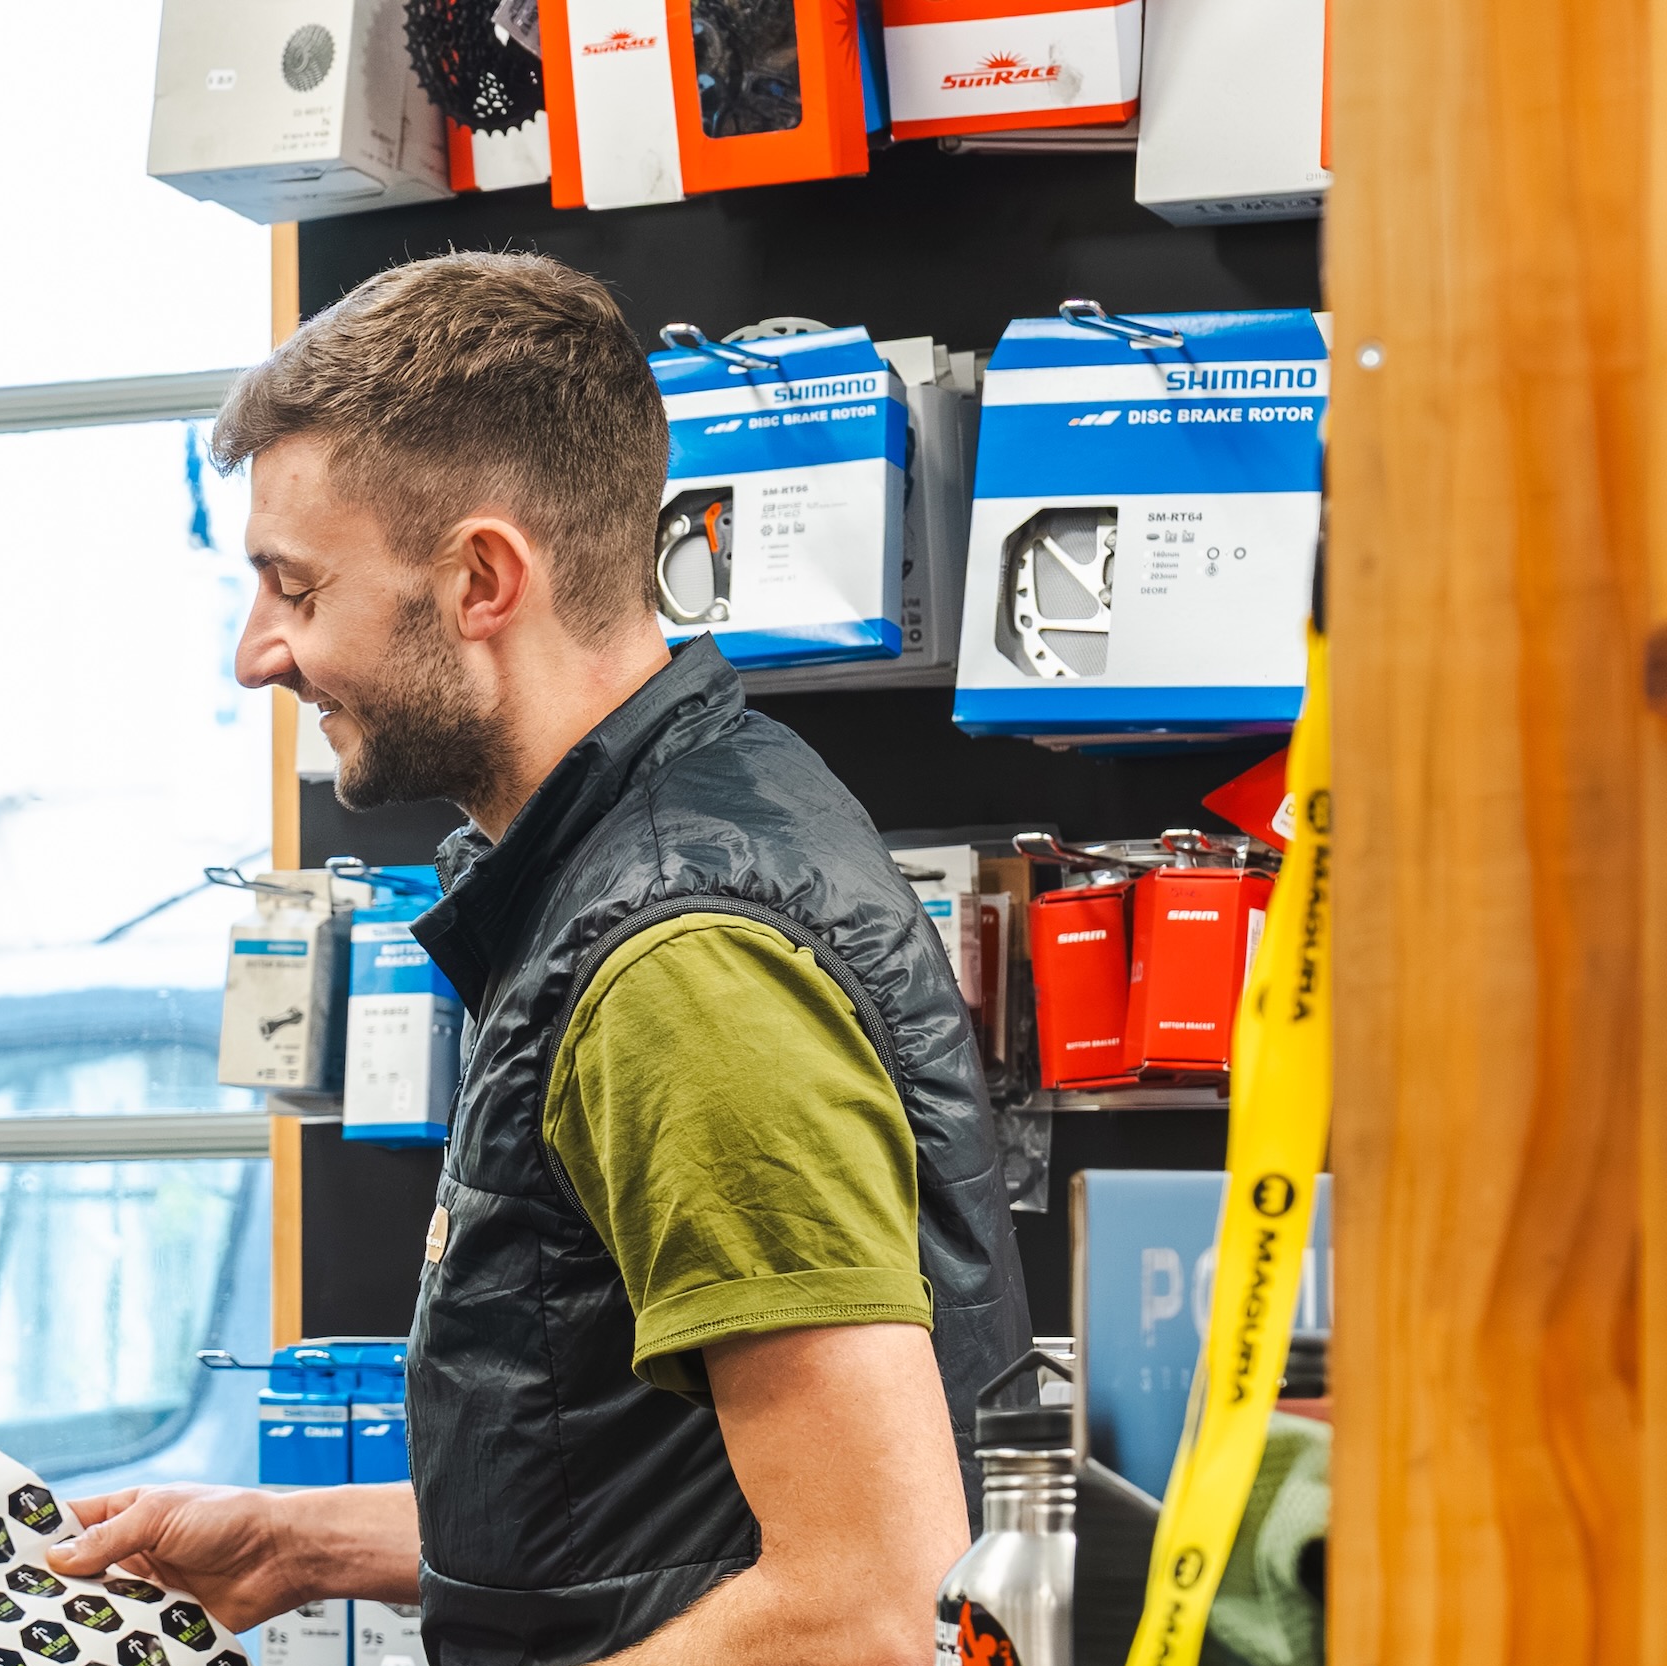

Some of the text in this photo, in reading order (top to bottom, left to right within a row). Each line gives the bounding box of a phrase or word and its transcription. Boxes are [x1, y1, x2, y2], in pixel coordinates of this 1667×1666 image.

[1166, 368, 1317, 391] SHIMANO
[773, 378, 876, 403] SHIMANO
[748, 405, 877, 430] DISC BRAKE ROTOR
[1127, 406, 1314, 425] DISC BRAKE ROTOR
[1147, 511, 1203, 522] SM-RT64
[1140, 586, 1168, 595] DEORE
[1167, 909, 1219, 922] SRAM
[1057, 929, 1107, 944] SRAM
[1159, 1020, 1216, 1031] BOTTOM BRACKET
[1232, 1229, 1277, 1403] MAGURA
